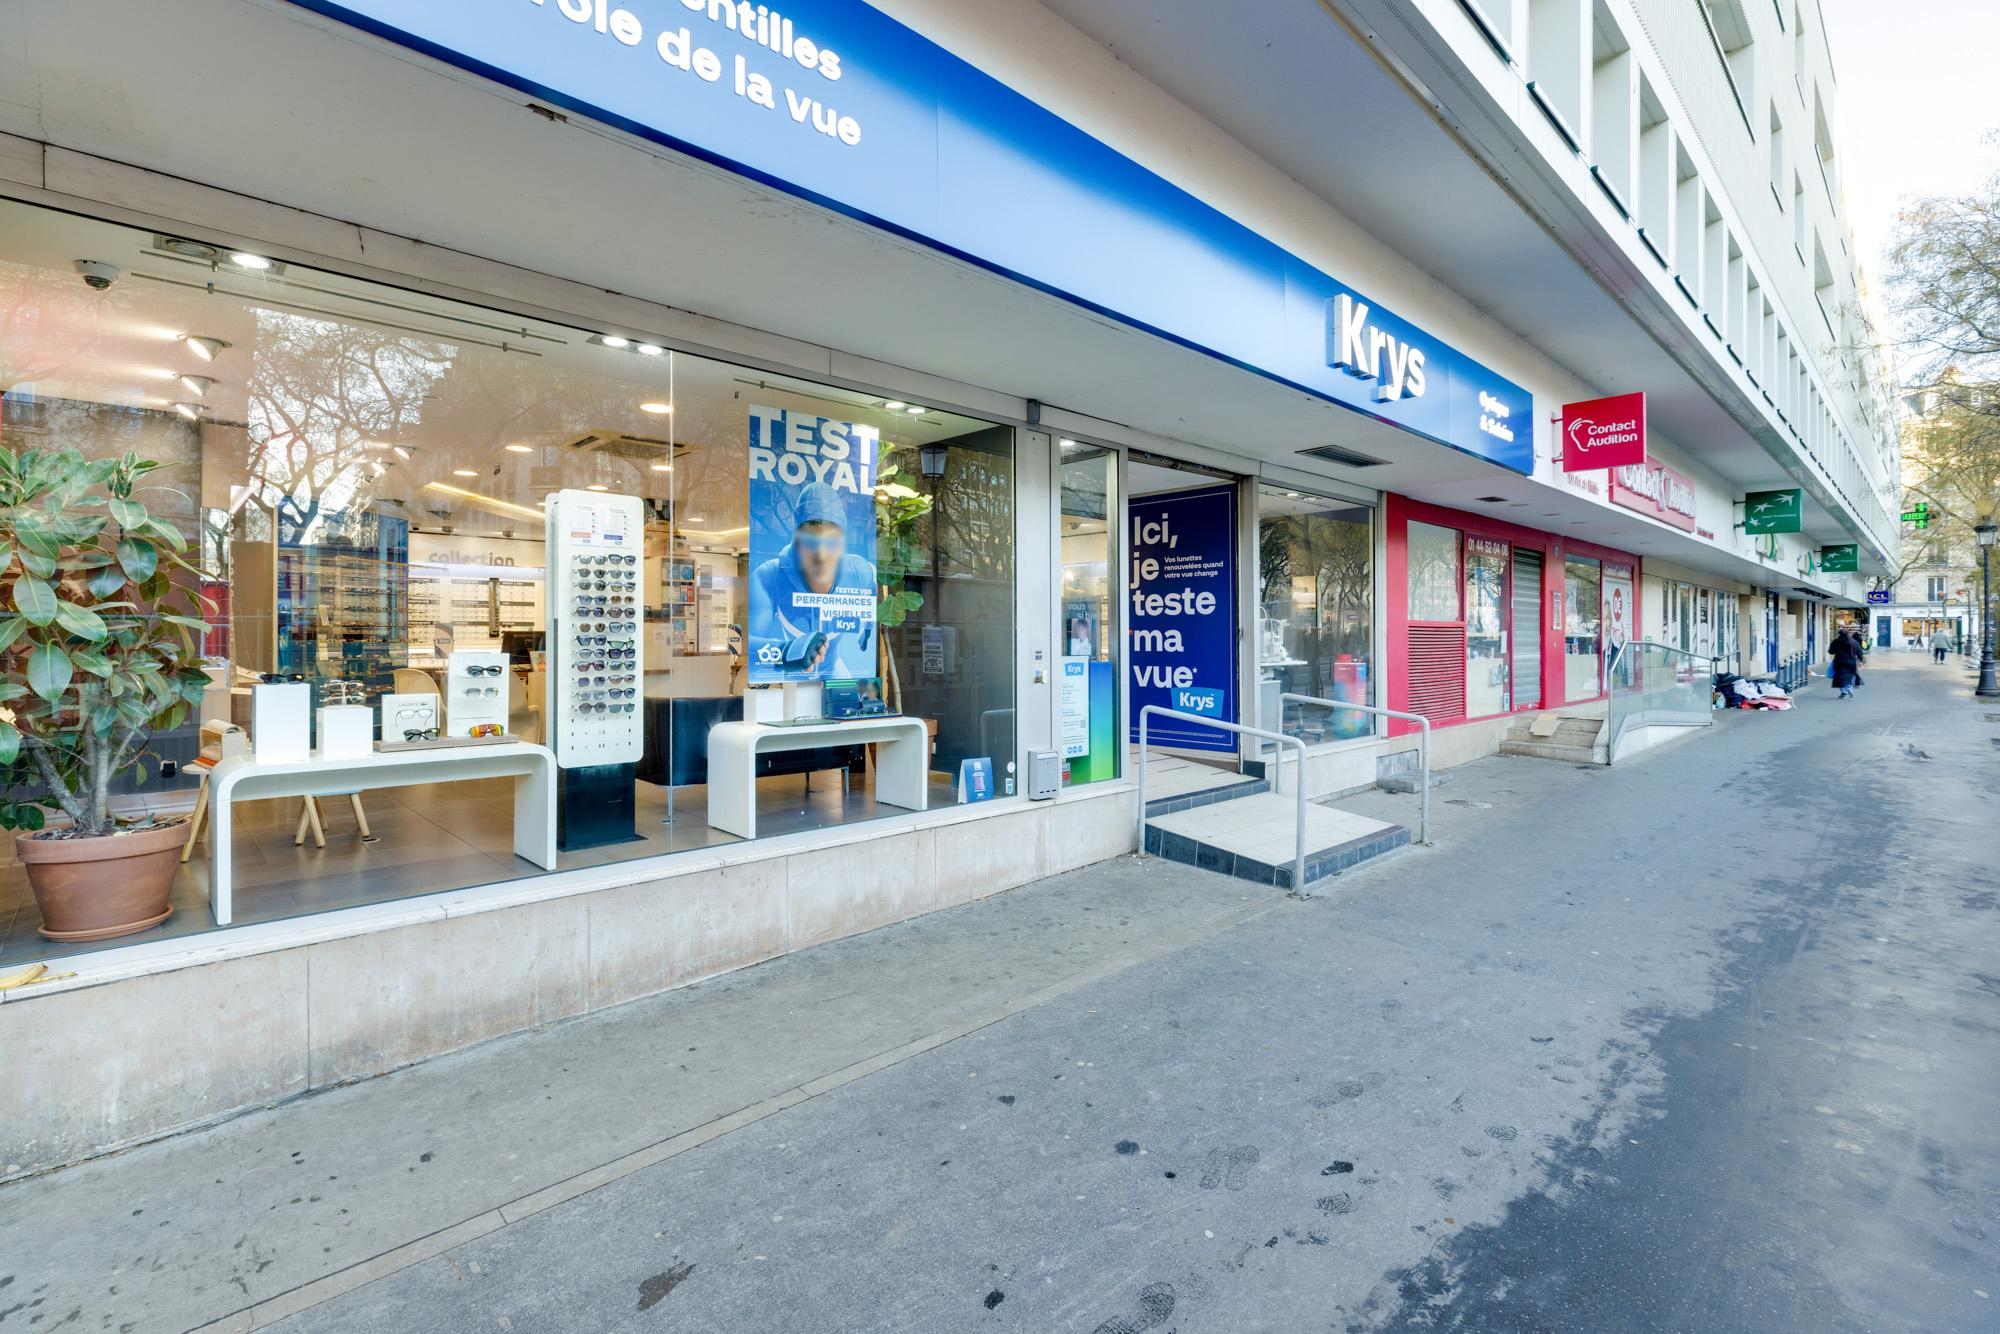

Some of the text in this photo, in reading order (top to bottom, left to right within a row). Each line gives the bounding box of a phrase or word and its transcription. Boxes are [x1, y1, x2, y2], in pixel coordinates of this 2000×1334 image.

[656, 27, 721, 82] de
[734, 54, 775, 110] la
[784, 87, 861, 146] vue
[1334, 292, 1426, 401] Krys
[749, 402, 880, 465] TEST
[1587, 419, 1636, 435] Contact
[1586, 432, 1638, 448] Audition
[749, 446, 876, 496] ROYAL
[1134, 512, 1178, 549] Ici,
[429, 549, 515, 567] collection
[1164, 560, 1224, 570] renouvelées quand
[1176, 555, 1203, 563] lunettes
[1130, 551, 1160, 589] je
[1194, 570, 1219, 578] change
[835, 586, 872, 595] TESTEZ VOS
[795, 595, 872, 606] PERFORMANCES
[1132, 587, 1217, 617] teste
[822, 609, 872, 619] VISUELLES
[836, 619, 856, 631] Krys
[1133, 629, 1184, 653] ma
[1067, 664, 1081, 675] Krys
[1179, 692, 1215, 712] Krys
